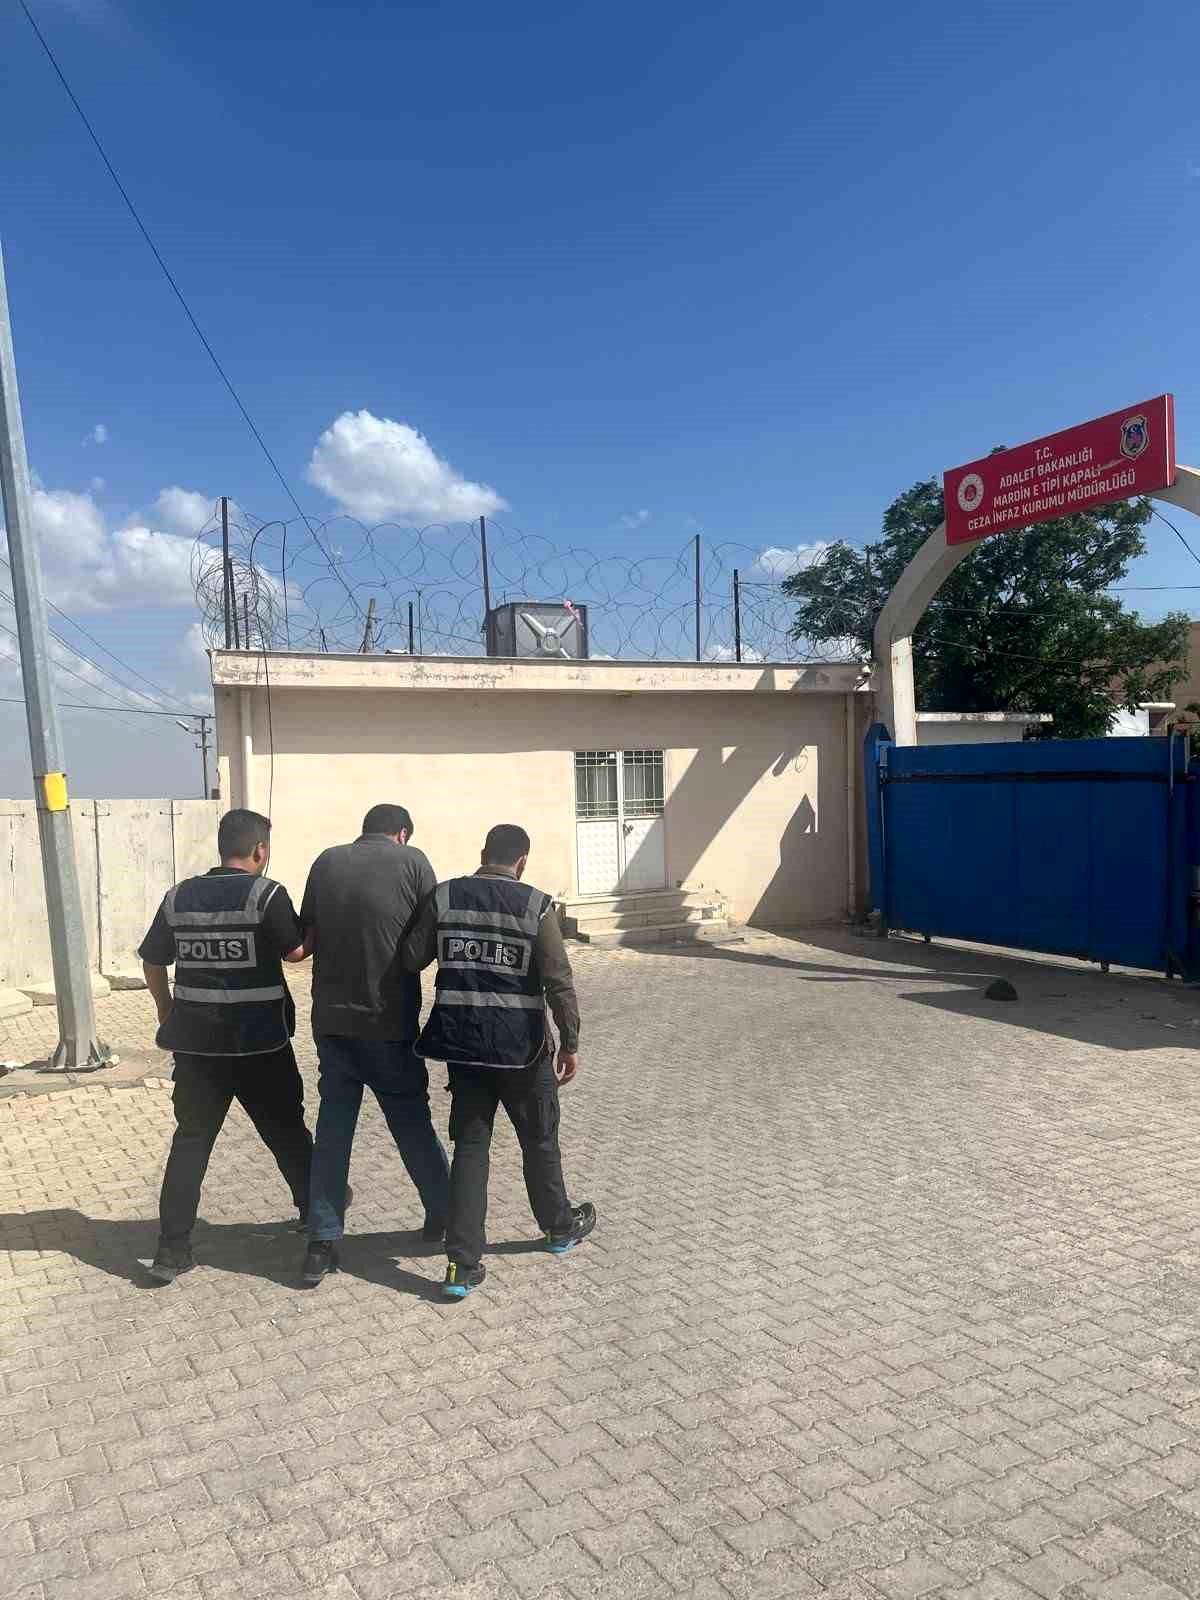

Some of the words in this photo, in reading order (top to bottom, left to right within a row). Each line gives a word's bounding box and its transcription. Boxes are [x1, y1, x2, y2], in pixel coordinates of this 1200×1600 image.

[1000, 467, 1036, 489] ADALET
[1037, 447, 1093, 475] BAKANLIĞI
[1034, 447, 1053, 461] T.C.
[968, 515, 991, 530] CEZA
[993, 506, 1020, 524] İNFAZ
[1022, 493, 1064, 516] KURUMU
[1067, 468, 1136, 502] MÜDÜRLÜĞÜ
[993, 486, 1030, 508] MARDİN
[1033, 484, 1039, 496] E
[1042, 475, 1060, 493] TİPİ
